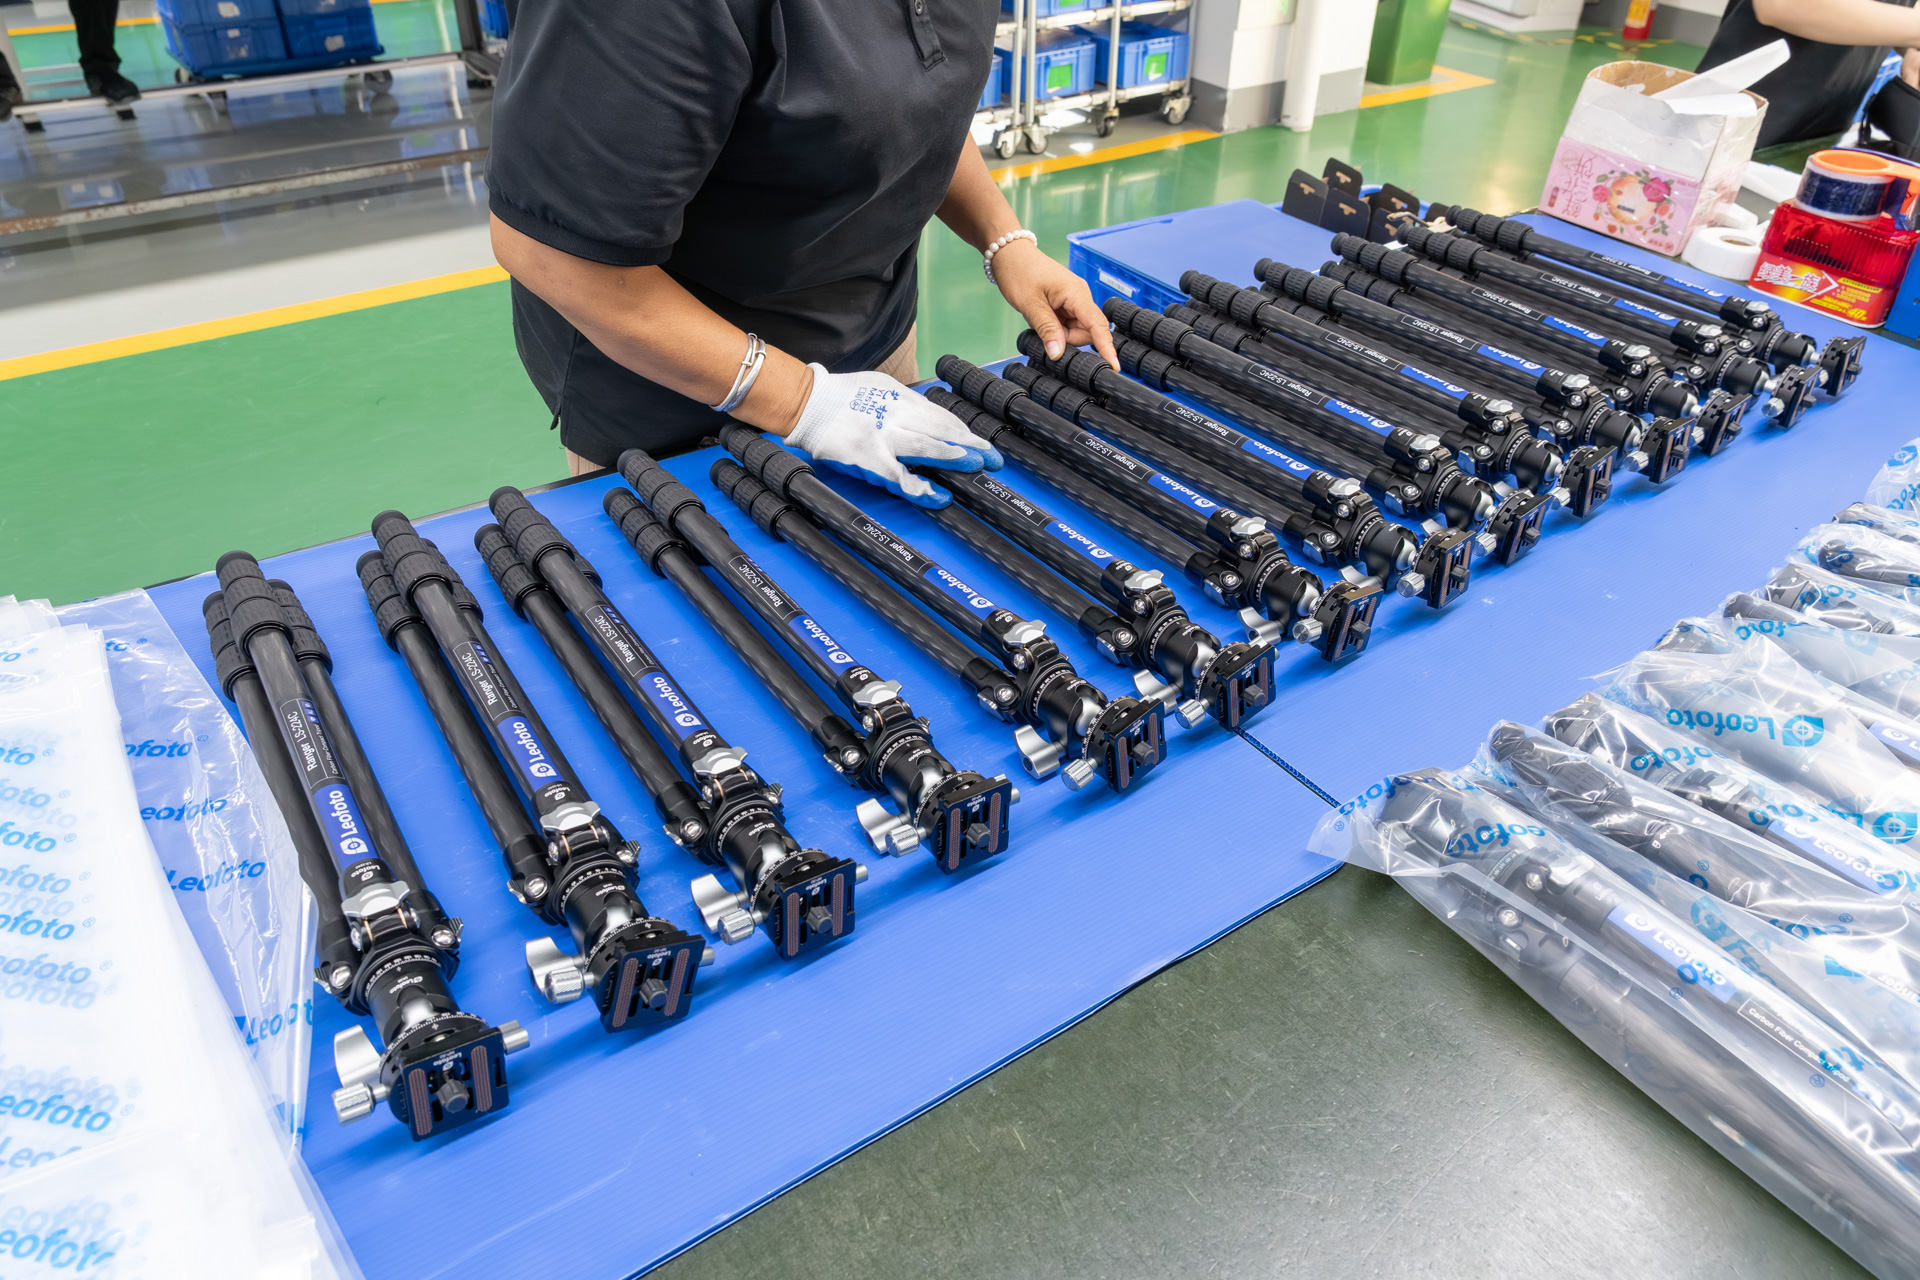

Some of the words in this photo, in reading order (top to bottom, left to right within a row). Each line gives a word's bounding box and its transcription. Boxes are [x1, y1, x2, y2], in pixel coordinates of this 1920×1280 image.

[1287, 381, 1312, 398] Ranger
[1203, 420, 1229, 437] Ranger
[1085, 438, 1112, 457] LS-224C
[1253, 440, 1293, 464] Leofoto
[1112, 452, 1137, 470] Ranger
[984, 480, 1011, 500] LS-224C
[1160, 475, 1200, 500] Leofoto
[1010, 496, 1035, 516] Ranger
[863, 523, 891, 548] LS-224C
[1058, 523, 1099, 551] Leofoto
[889, 542, 914, 562] Ranger
[738, 563, 764, 590] LS-224C
[937, 569, 978, 600] Leofoto
[761, 585, 784, 608] Ranger
[594, 615, 618, 641] LS-224C
[803, 618, 841, 653] Leofoto
[615, 638, 636, 664] Ranger
[462, 652, 483, 681] LS-224C
[479, 677, 498, 706] Ranger
[653, 676, 689, 715] Leofoto
[287, 711, 306, 743] LS-224C
[1666, 708, 1775, 740] Leofoto
[126, 740, 193, 758] ofoto
[512, 721, 545, 763] Leofoto
[301, 742, 318, 772] Ranger
[141, 797, 228, 822] eofoto
[329, 790, 359, 838] Leofoto
[1446, 823, 1547, 858] eofoto
[350, 864, 380, 878] Leofoto
[0, 910, 75, 941] ofoto
[1748, 1007, 1775, 1030] Carbon
[1774, 1024, 1794, 1043] Fiber
[433, 1052, 462, 1067] Leofoto
[0, 1094, 112, 1132] eofoto
